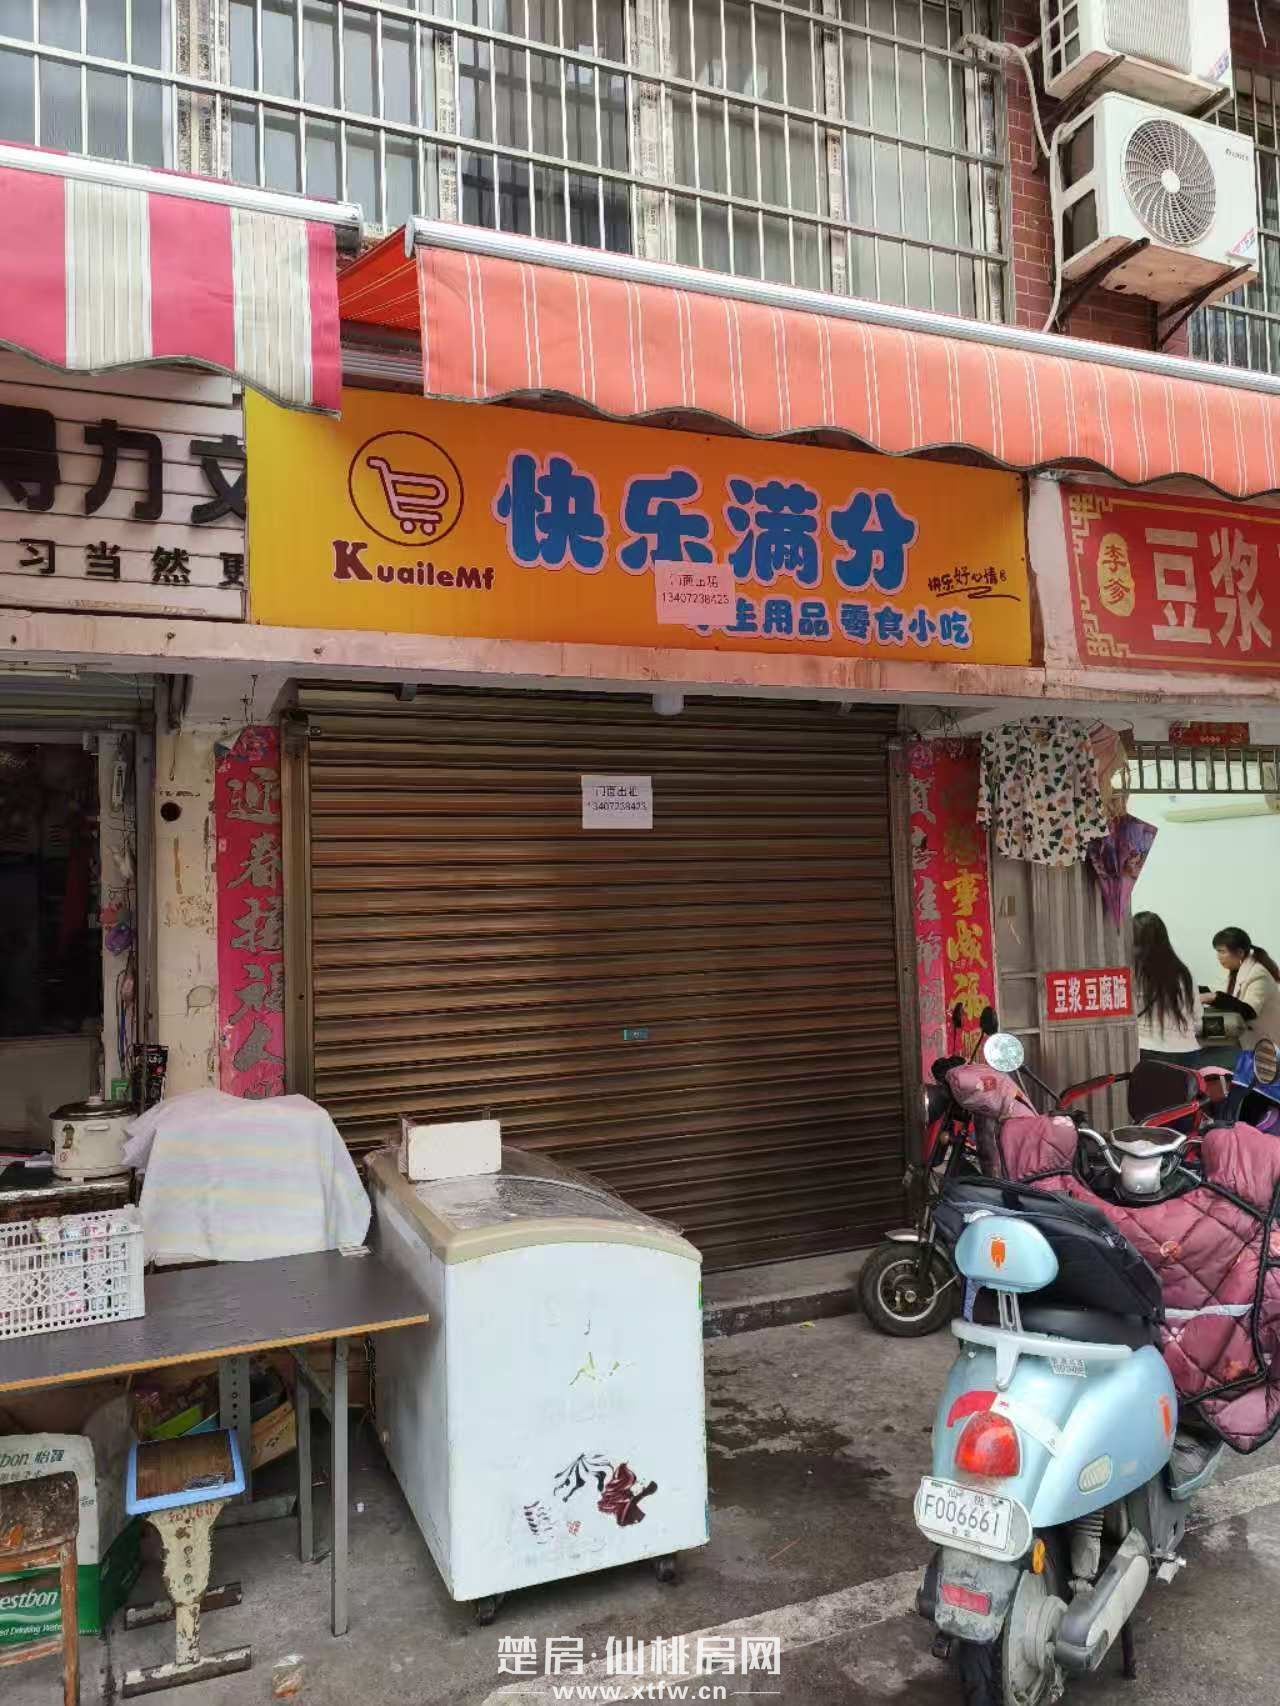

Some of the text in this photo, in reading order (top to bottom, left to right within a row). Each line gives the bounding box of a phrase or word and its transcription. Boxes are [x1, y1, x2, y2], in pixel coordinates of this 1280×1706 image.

[495, 453, 917, 593] 快乐满分
[332, 539, 495, 590] KuaileMf
[1145, 527, 1280, 651] 豆浆
[697, 597, 970, 644] 生用品 零食小吃
[1053, 974, 1127, 1013] 豆浆 豆腐脑
[924, 1494, 999, 1537] F006661
